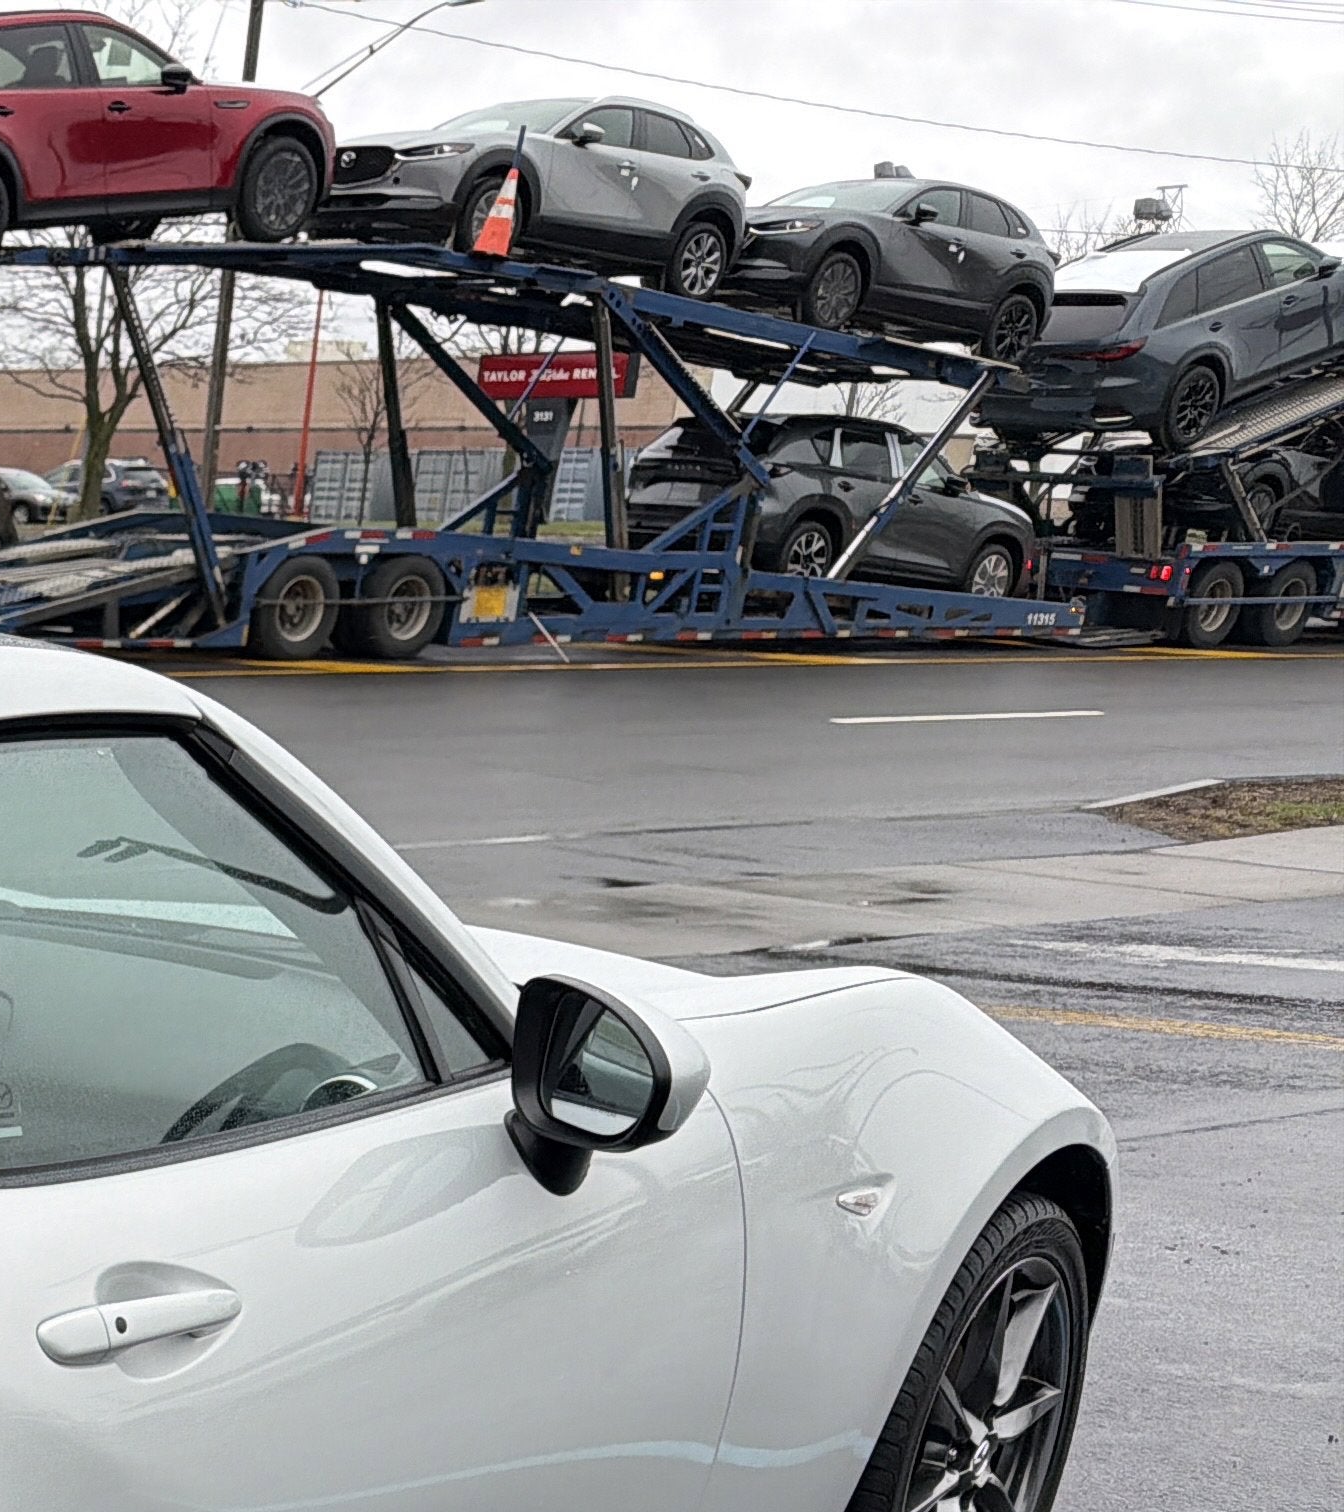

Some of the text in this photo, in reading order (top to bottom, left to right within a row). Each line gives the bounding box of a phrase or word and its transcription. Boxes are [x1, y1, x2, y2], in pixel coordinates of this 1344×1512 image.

[483, 370, 526, 382] TAYLOR
[572, 367, 621, 380] RENL
[1027, 613, 1056, 626] 11315
